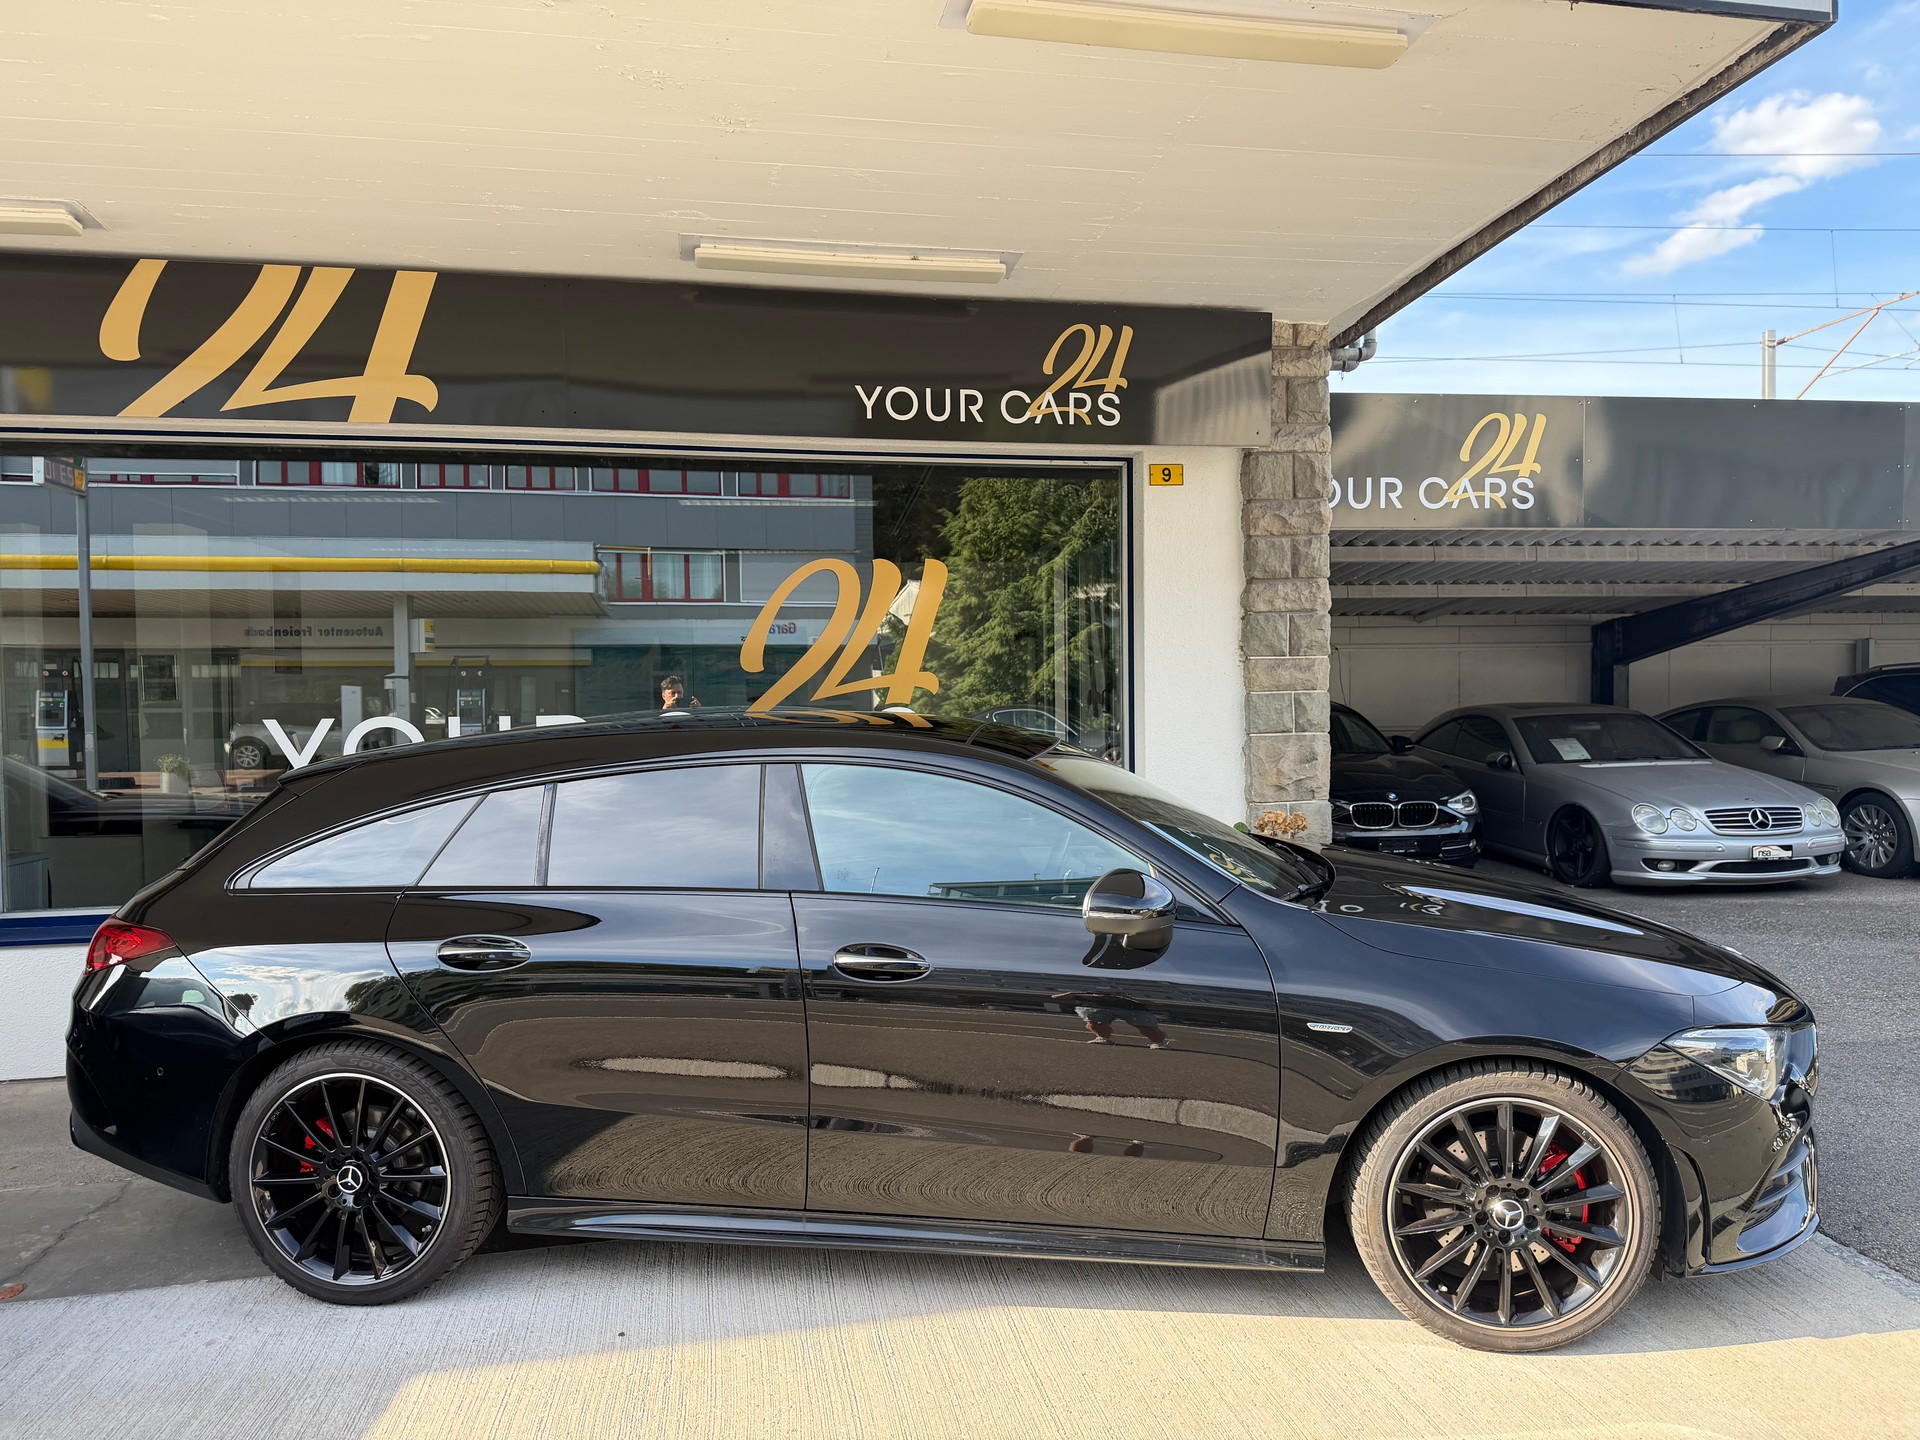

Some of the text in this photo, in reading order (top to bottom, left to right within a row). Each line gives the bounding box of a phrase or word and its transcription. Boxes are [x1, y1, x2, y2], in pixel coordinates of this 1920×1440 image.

[855, 385, 1121, 426] YOUR CARS
[1027, 323, 1133, 425] 24
[1162, 467, 1172, 482] 9
[1418, 477, 1535, 509] CARS
[1444, 413, 1547, 509] 24
[739, 558, 949, 712] 24
